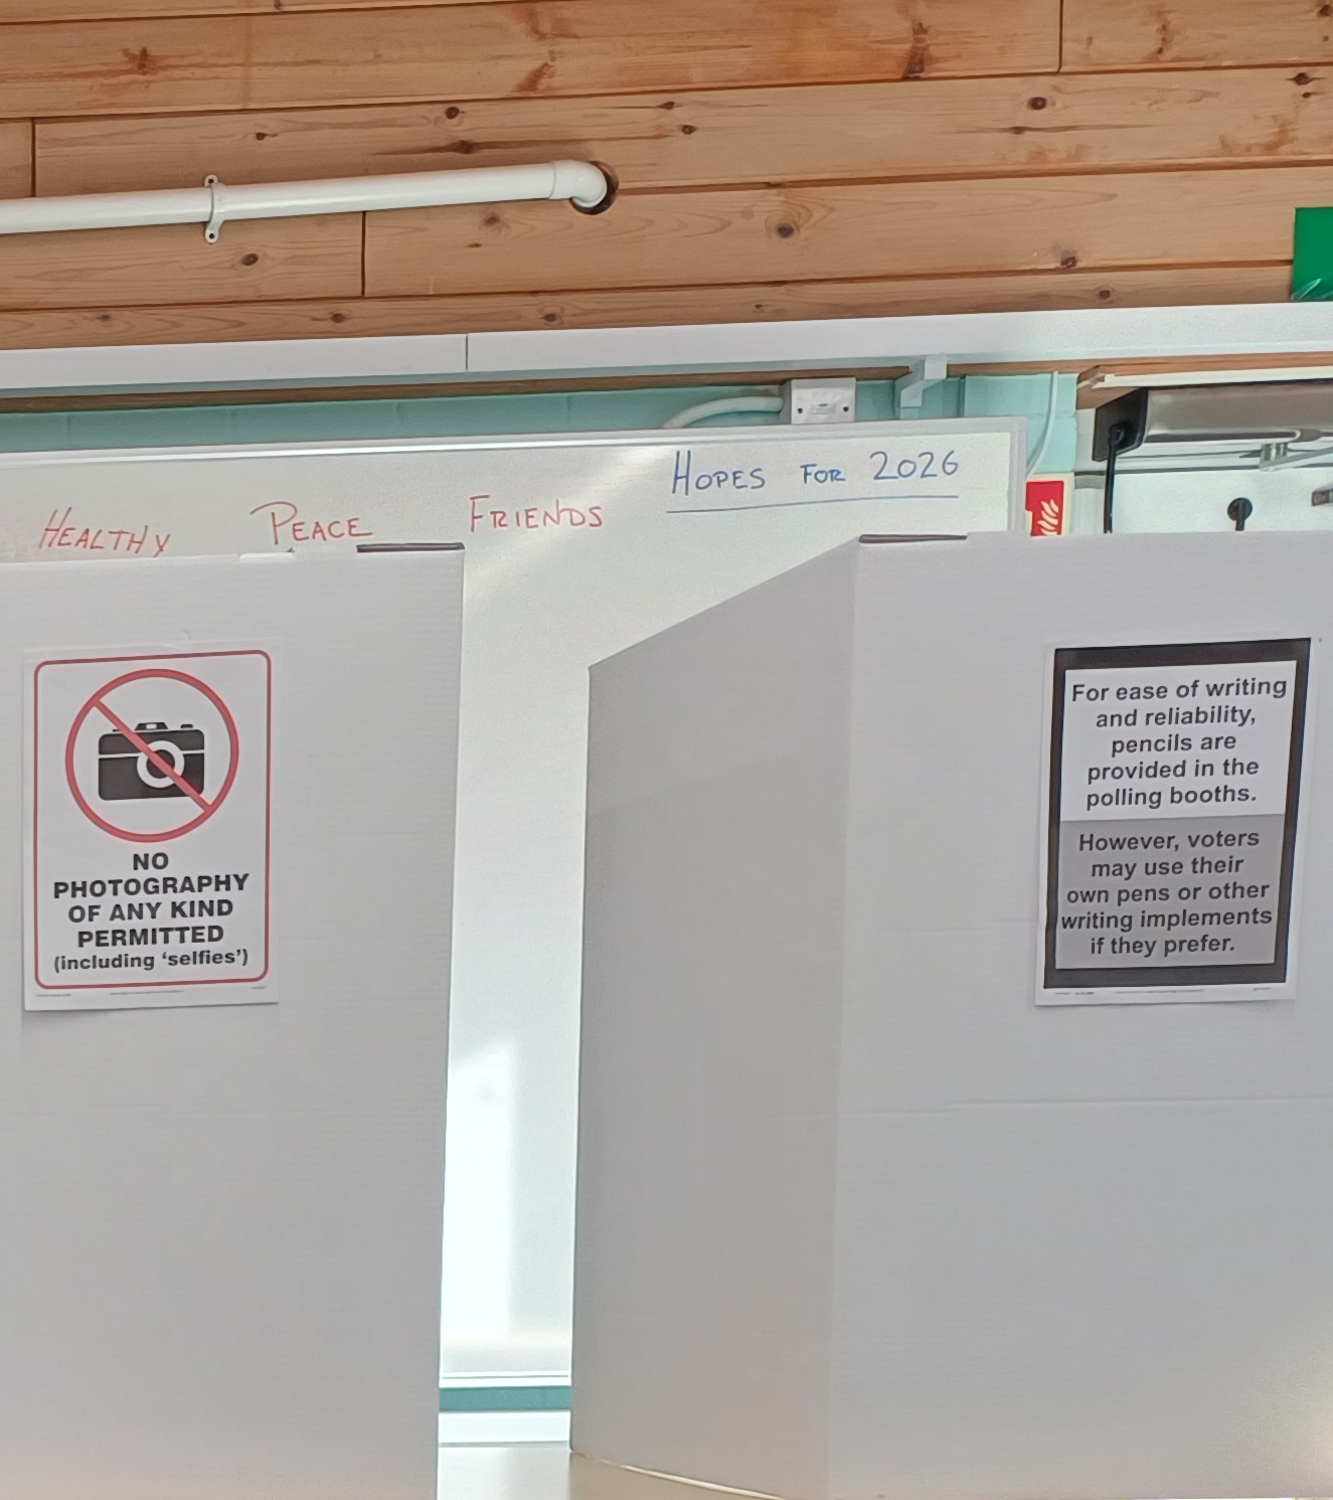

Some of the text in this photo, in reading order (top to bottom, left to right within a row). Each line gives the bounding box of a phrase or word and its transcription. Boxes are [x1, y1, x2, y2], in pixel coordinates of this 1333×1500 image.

[672, 450, 959, 496] HOPES FOR 2026
[250, 501, 373, 545] PEACE
[469, 494, 603, 531] FRIENDS
[38, 507, 171, 557] HEALTHY
[1072, 677, 1287, 702] For ease of writing
[1096, 705, 1256, 728] and reliability,
[1111, 734, 1237, 757] pencils are
[1088, 757, 1259, 785] provided in the
[1087, 785, 1257, 811] polling booths.
[1079, 831, 1260, 852] However, voters
[133, 852, 169, 871] NO
[1091, 856, 1244, 881] may use their
[54, 873, 250, 899] PHOTOGRAPHY
[1067, 881, 1270, 907] own pens or other
[68, 899, 233, 923] OF ANY KIND
[1062, 907, 1273, 932] writing implements
[78, 925, 224, 948] PERMITTED
[1091, 935, 1235, 958] if they prefer.
[54, 953, 155, 973] (including
